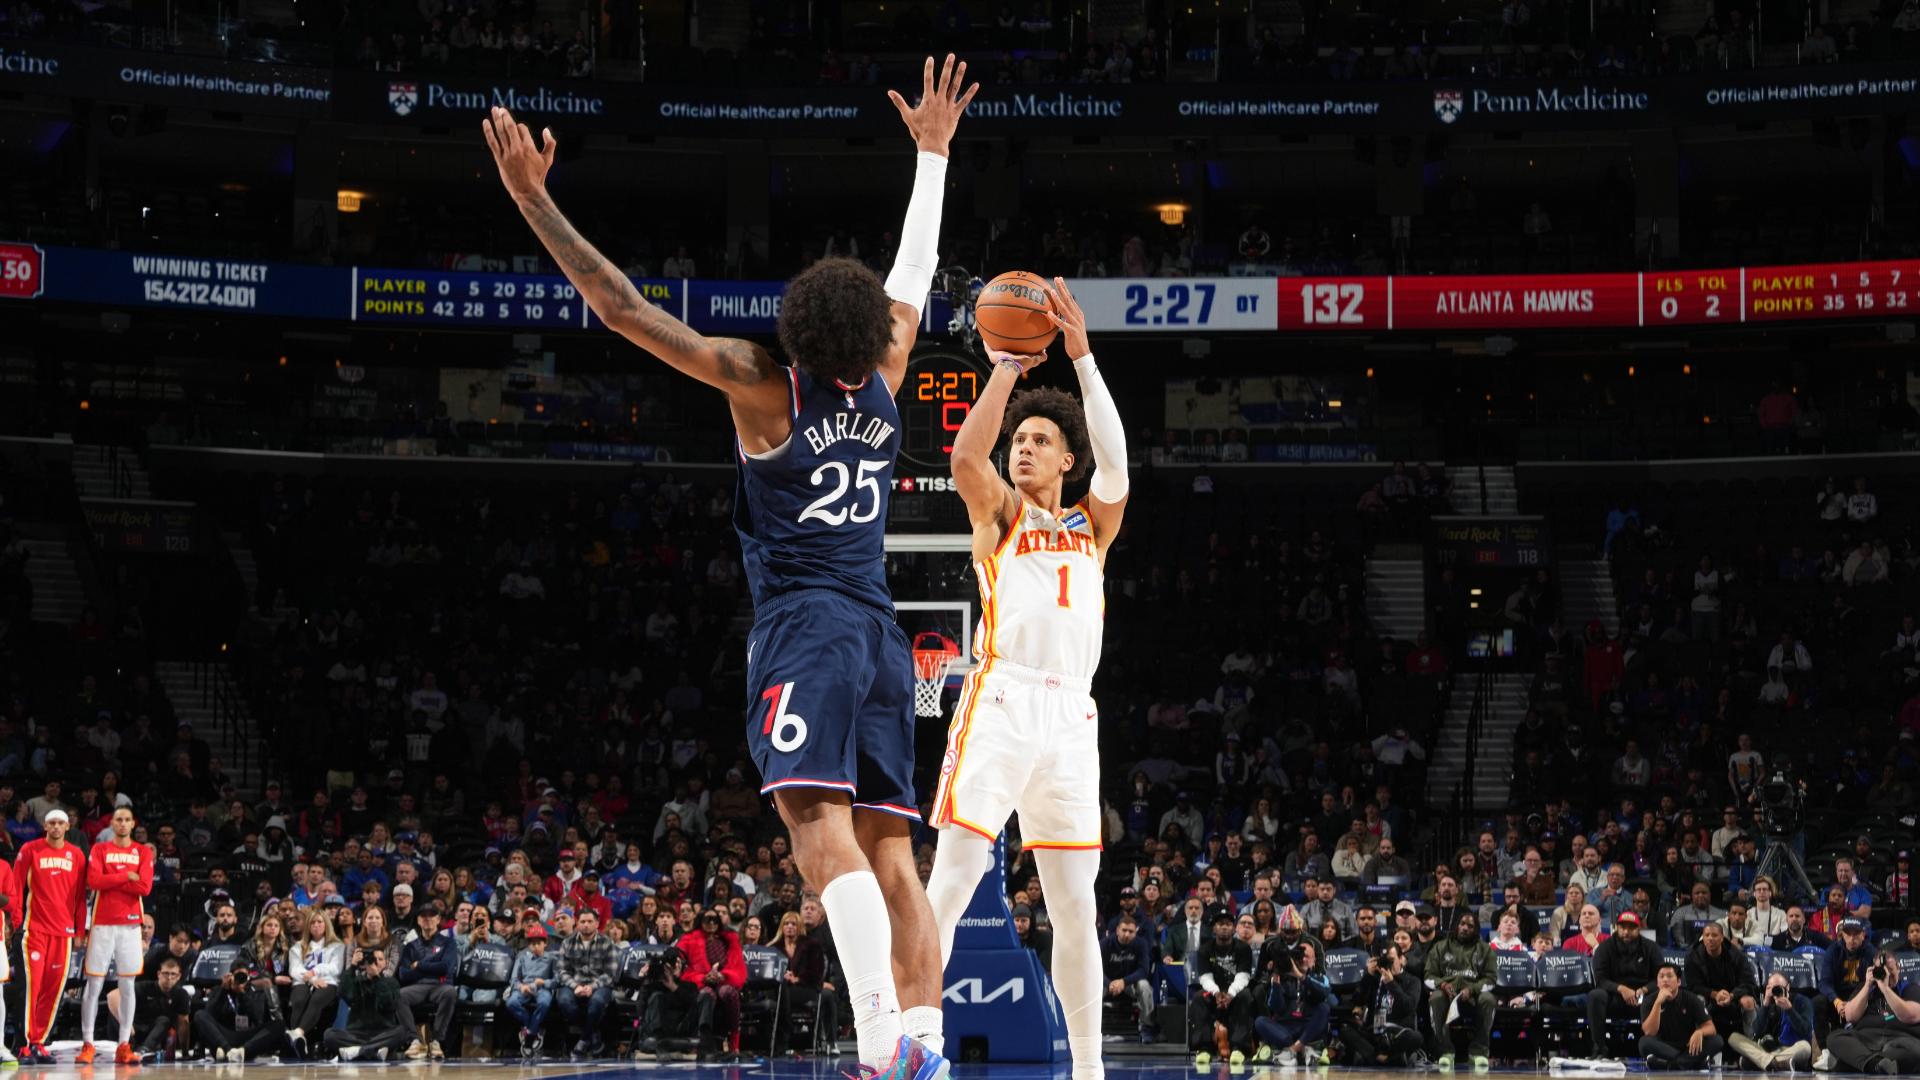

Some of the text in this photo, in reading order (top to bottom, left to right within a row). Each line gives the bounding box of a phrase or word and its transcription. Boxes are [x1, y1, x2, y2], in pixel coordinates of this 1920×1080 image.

[0, 49, 58, 75] icine
[120, 67, 330, 101] Official Healthcare Partner
[1706, 79, 1917, 105] Official Healthcare Partner
[427, 84, 604, 114] Penn Medicine
[660, 102, 858, 119] Official Healthcare Partner
[962, 91, 1122, 117] enn Medicine
[1178, 100, 1380, 116] Official Healthcare Partner
[1473, 85, 1648, 113] Penn Medicine
[133, 256, 268, 283] WINNING TICKET
[1752, 270, 1900, 292] PLAYER 1 5 7
[144, 279, 256, 308] 1542124001
[364, 278, 576, 300] PLAYER 0 5 20 25 30
[641, 283, 671, 299] TOL
[1657, 276, 1728, 292] FLS TOL
[364, 299, 570, 320] POINTS 42 28 5 10 4
[710, 294, 782, 319] PHILADE
[1125, 284, 1259, 325] 2:27 OT
[1301, 283, 1364, 324] 132
[1436, 289, 1594, 314] ATLANTA HAWKS
[1661, 295, 1720, 318] 0 2
[1753, 291, 1907, 314] POINTS 35 15 32
[918, 372, 977, 401] 2:27
[803, 412, 896, 456] BARLOW
[798, 459, 890, 526] 25
[916, 477, 957, 491] TISS
[164, 535, 190, 551] 120
[1015, 529, 1093, 557] ATLANT
[1471, 525, 1503, 543] Rock
[1478, 551, 1498, 562] EXIT
[1516, 549, 1539, 565] 118
[1056, 564, 1072, 609] 1
[762, 681, 808, 753] 76
[956, 916, 1006, 928] ketmaster
[1545, 956, 1566, 968] NJM
[1773, 956, 1795, 969] NJM
